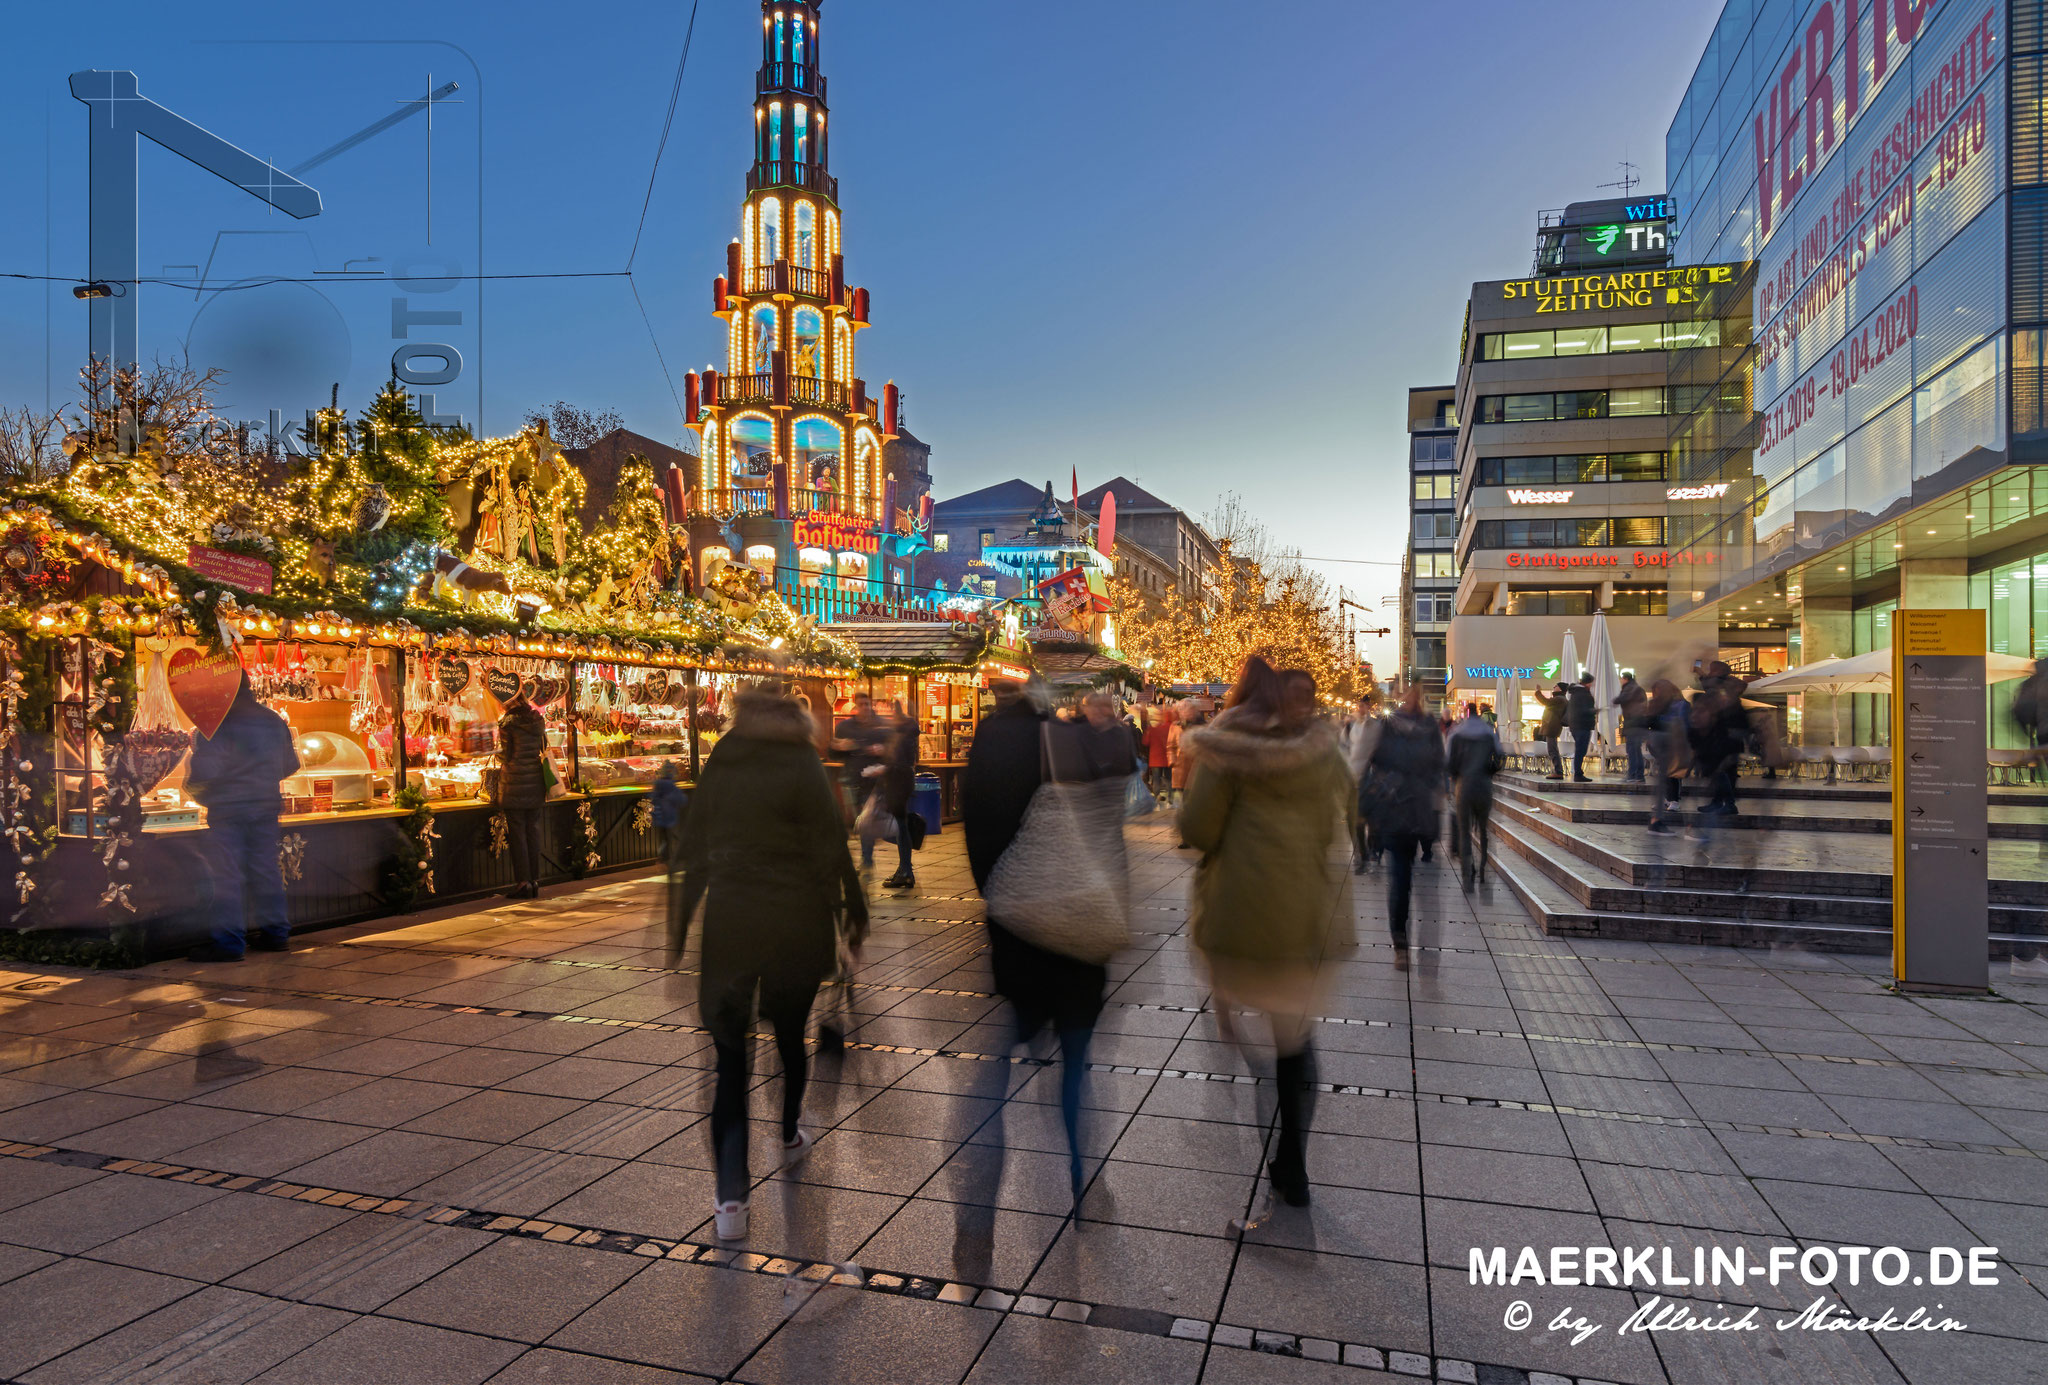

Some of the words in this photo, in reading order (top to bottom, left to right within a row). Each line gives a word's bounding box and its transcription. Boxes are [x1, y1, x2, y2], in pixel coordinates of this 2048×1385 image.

[1760, 280, 1774, 327] OP
[1776, 248, 1797, 310] ART
[1801, 214, 1828, 280] UND
[1832, 166, 1865, 245] EINE
[1869, 5, 1995, 201] GESCHICHTE
[1760, 319, 1780, 374] DES
[1783, 222, 1867, 350] SCHWINDELS
[1872, 172, 1913, 257] 1520
[1935, 92, 1986, 191] 1970
[1536, 289, 1653, 314] ZEITUNG
[1759, 376, 1815, 457] 23.11.2019
[1829, 284, 1919, 400] 19.04.2020
[1507, 489, 1574, 504] Wesser
[808, 509, 874, 529] Stuttgarter
[793, 519, 879, 555] Hofbräu
[1506, 552, 1619, 570] Stuttgarter
[857, 601, 891, 618] XXL
[898, 605, 954, 623] Imbis
[169, 662, 193, 678] Unser
[1465, 664, 1534, 679] wittwer
